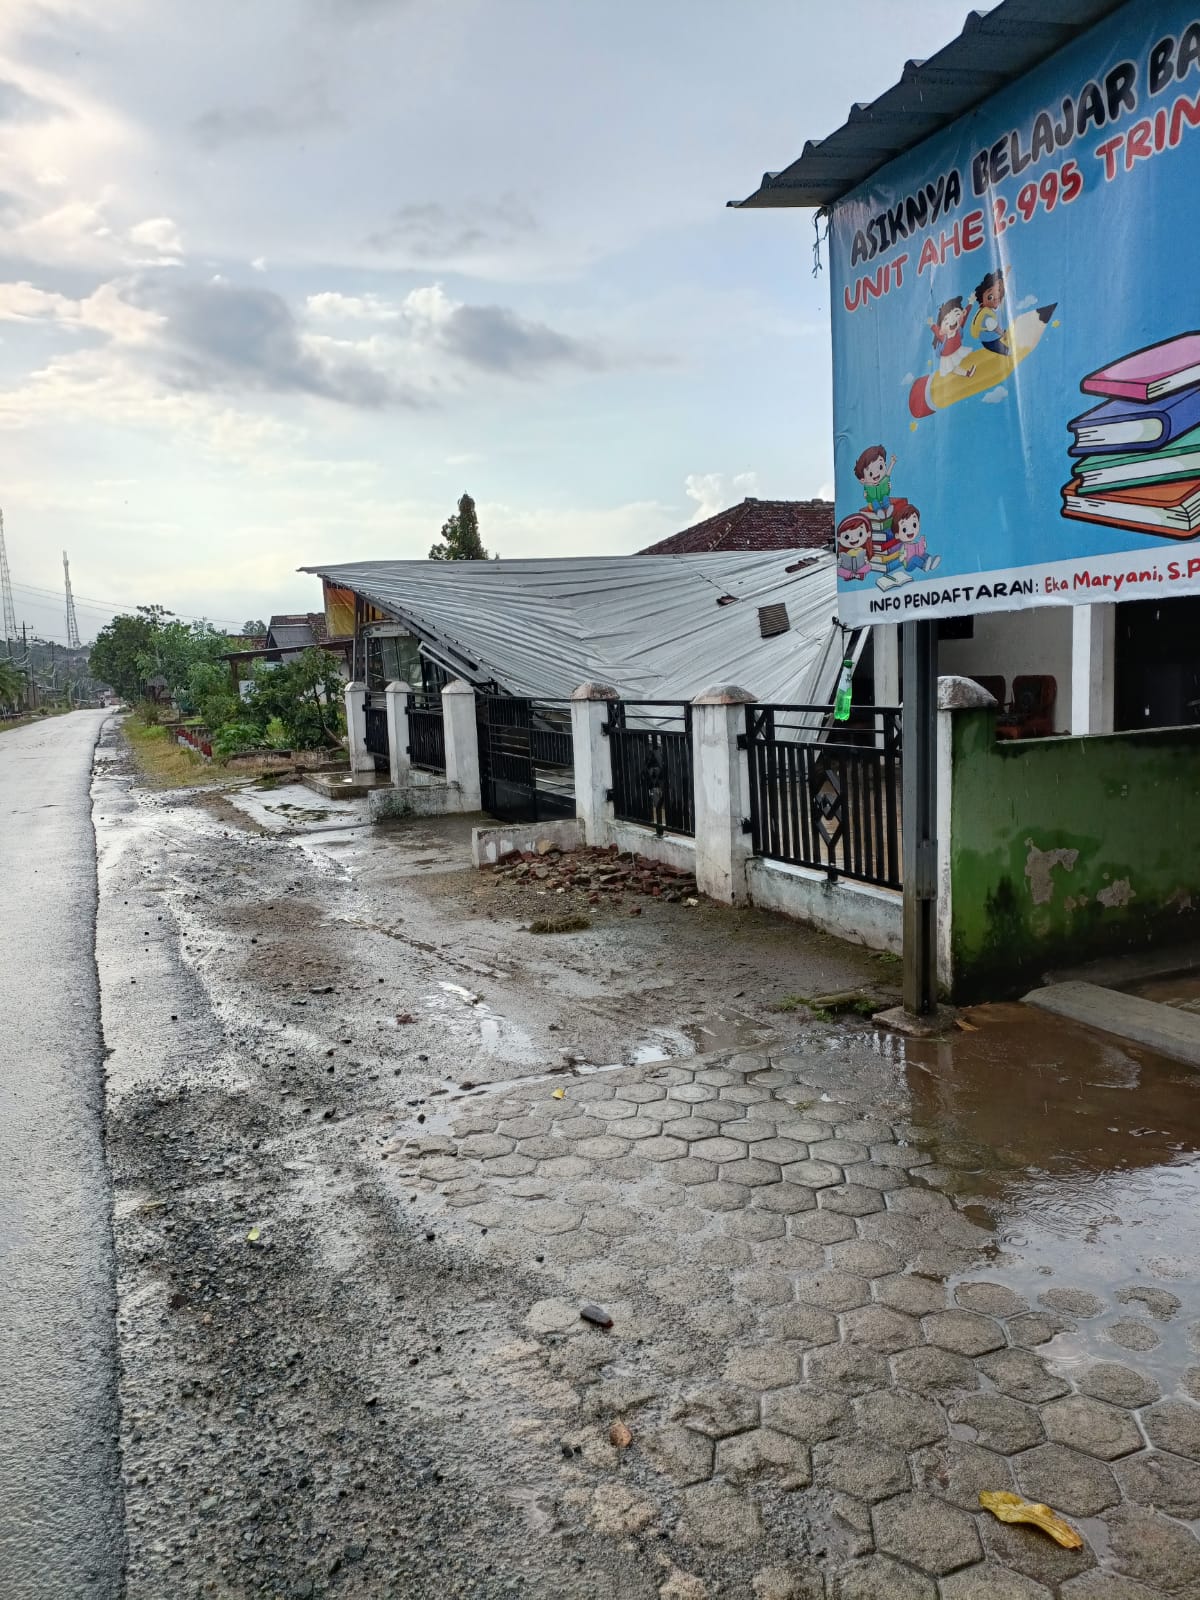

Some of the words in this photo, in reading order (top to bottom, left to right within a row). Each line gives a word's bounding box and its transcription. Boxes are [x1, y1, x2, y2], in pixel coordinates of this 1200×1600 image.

[851, 171, 961, 266] ASIKNYA
[972, 62, 1136, 196] BELAJAR
[844, 255, 908, 311] UNIT
[917, 211, 984, 274] AHE
[869, 597, 902, 613] INFO
[904, 579, 1040, 609] PENDAFTARAN:
[1044, 576, 1069, 594] Eka
[1073, 565, 1164, 593] Maryani,
